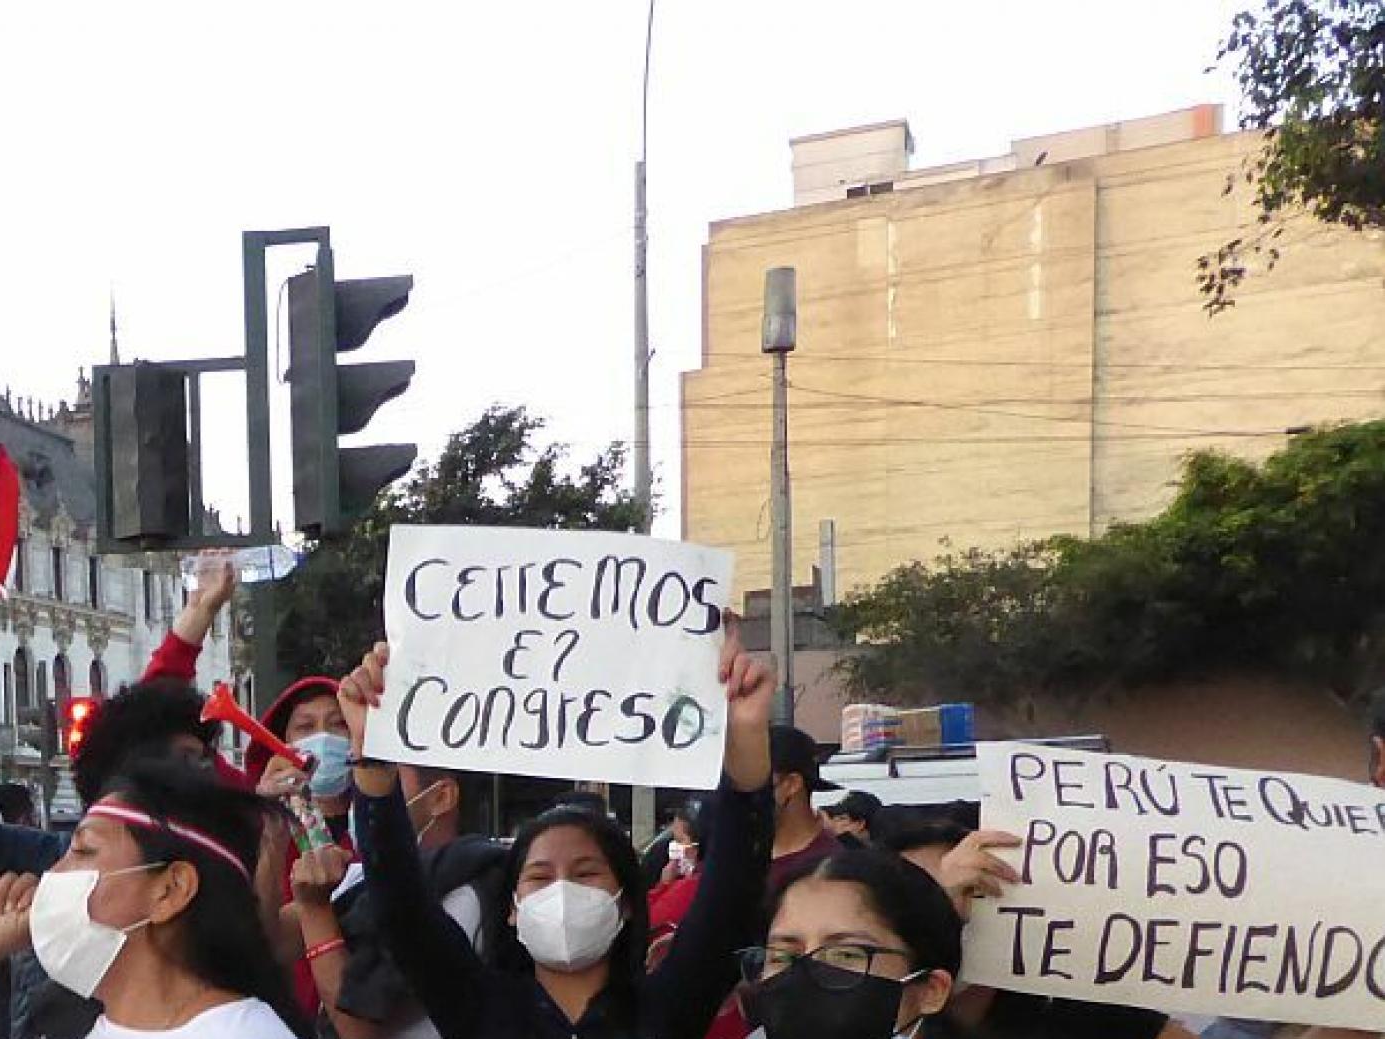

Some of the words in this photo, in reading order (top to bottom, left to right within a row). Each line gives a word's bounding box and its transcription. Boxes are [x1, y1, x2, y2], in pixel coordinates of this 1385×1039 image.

[1009, 752, 1181, 816] PERÚ
[1191, 774, 1254, 822] TE
[1021, 819, 1118, 890] POR
[1147, 833, 1248, 899] ESO
[998, 906, 1074, 980] TE
